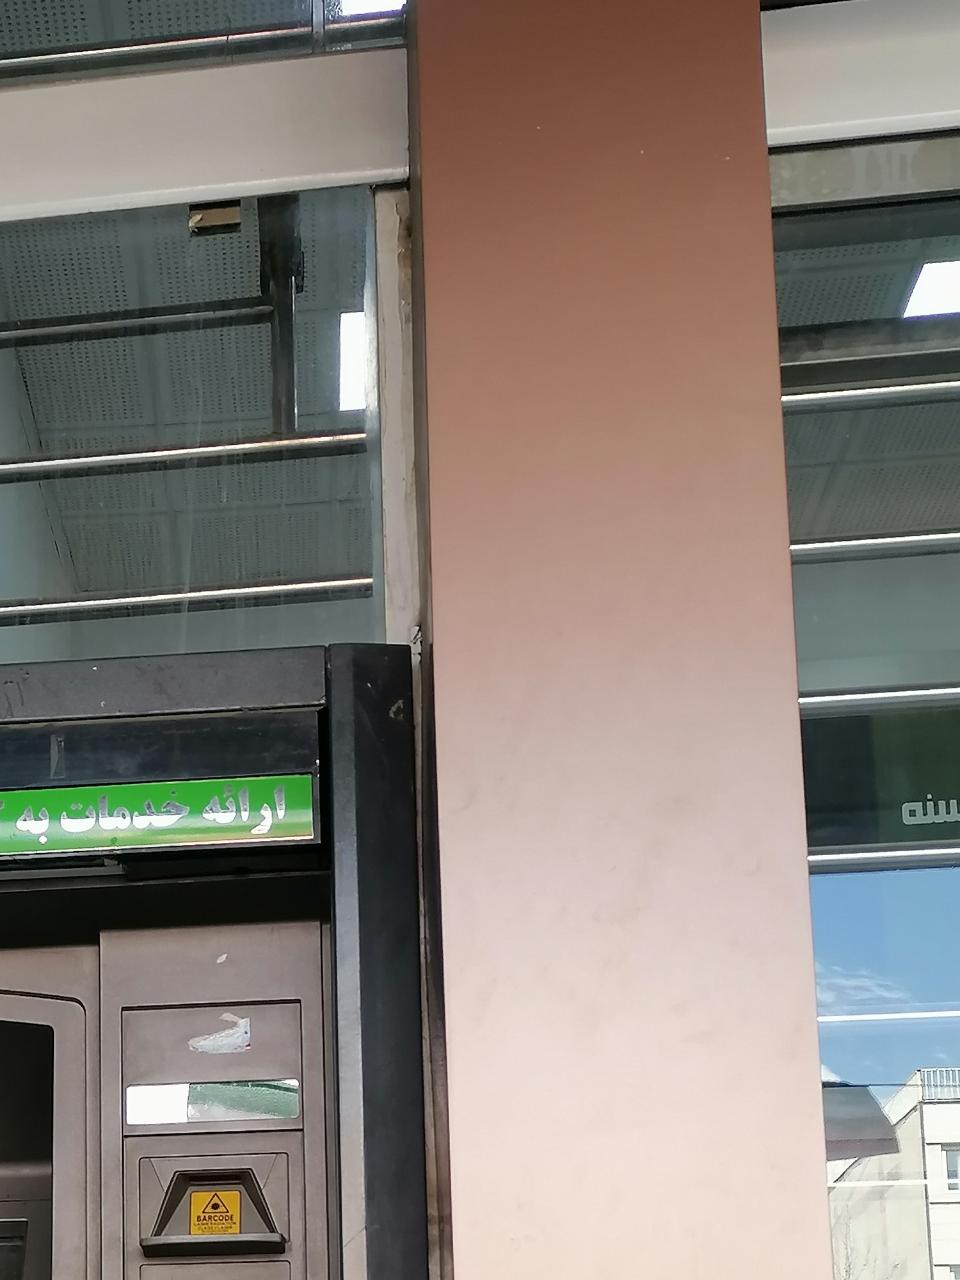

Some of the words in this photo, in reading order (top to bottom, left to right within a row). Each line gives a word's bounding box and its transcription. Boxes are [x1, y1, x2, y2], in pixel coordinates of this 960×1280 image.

[15, 804, 51, 844] به
[59, 788, 191, 833] خدمات
[201, 783, 286, 835] ارائه
[196, 1214, 234, 1222] BARCODE
